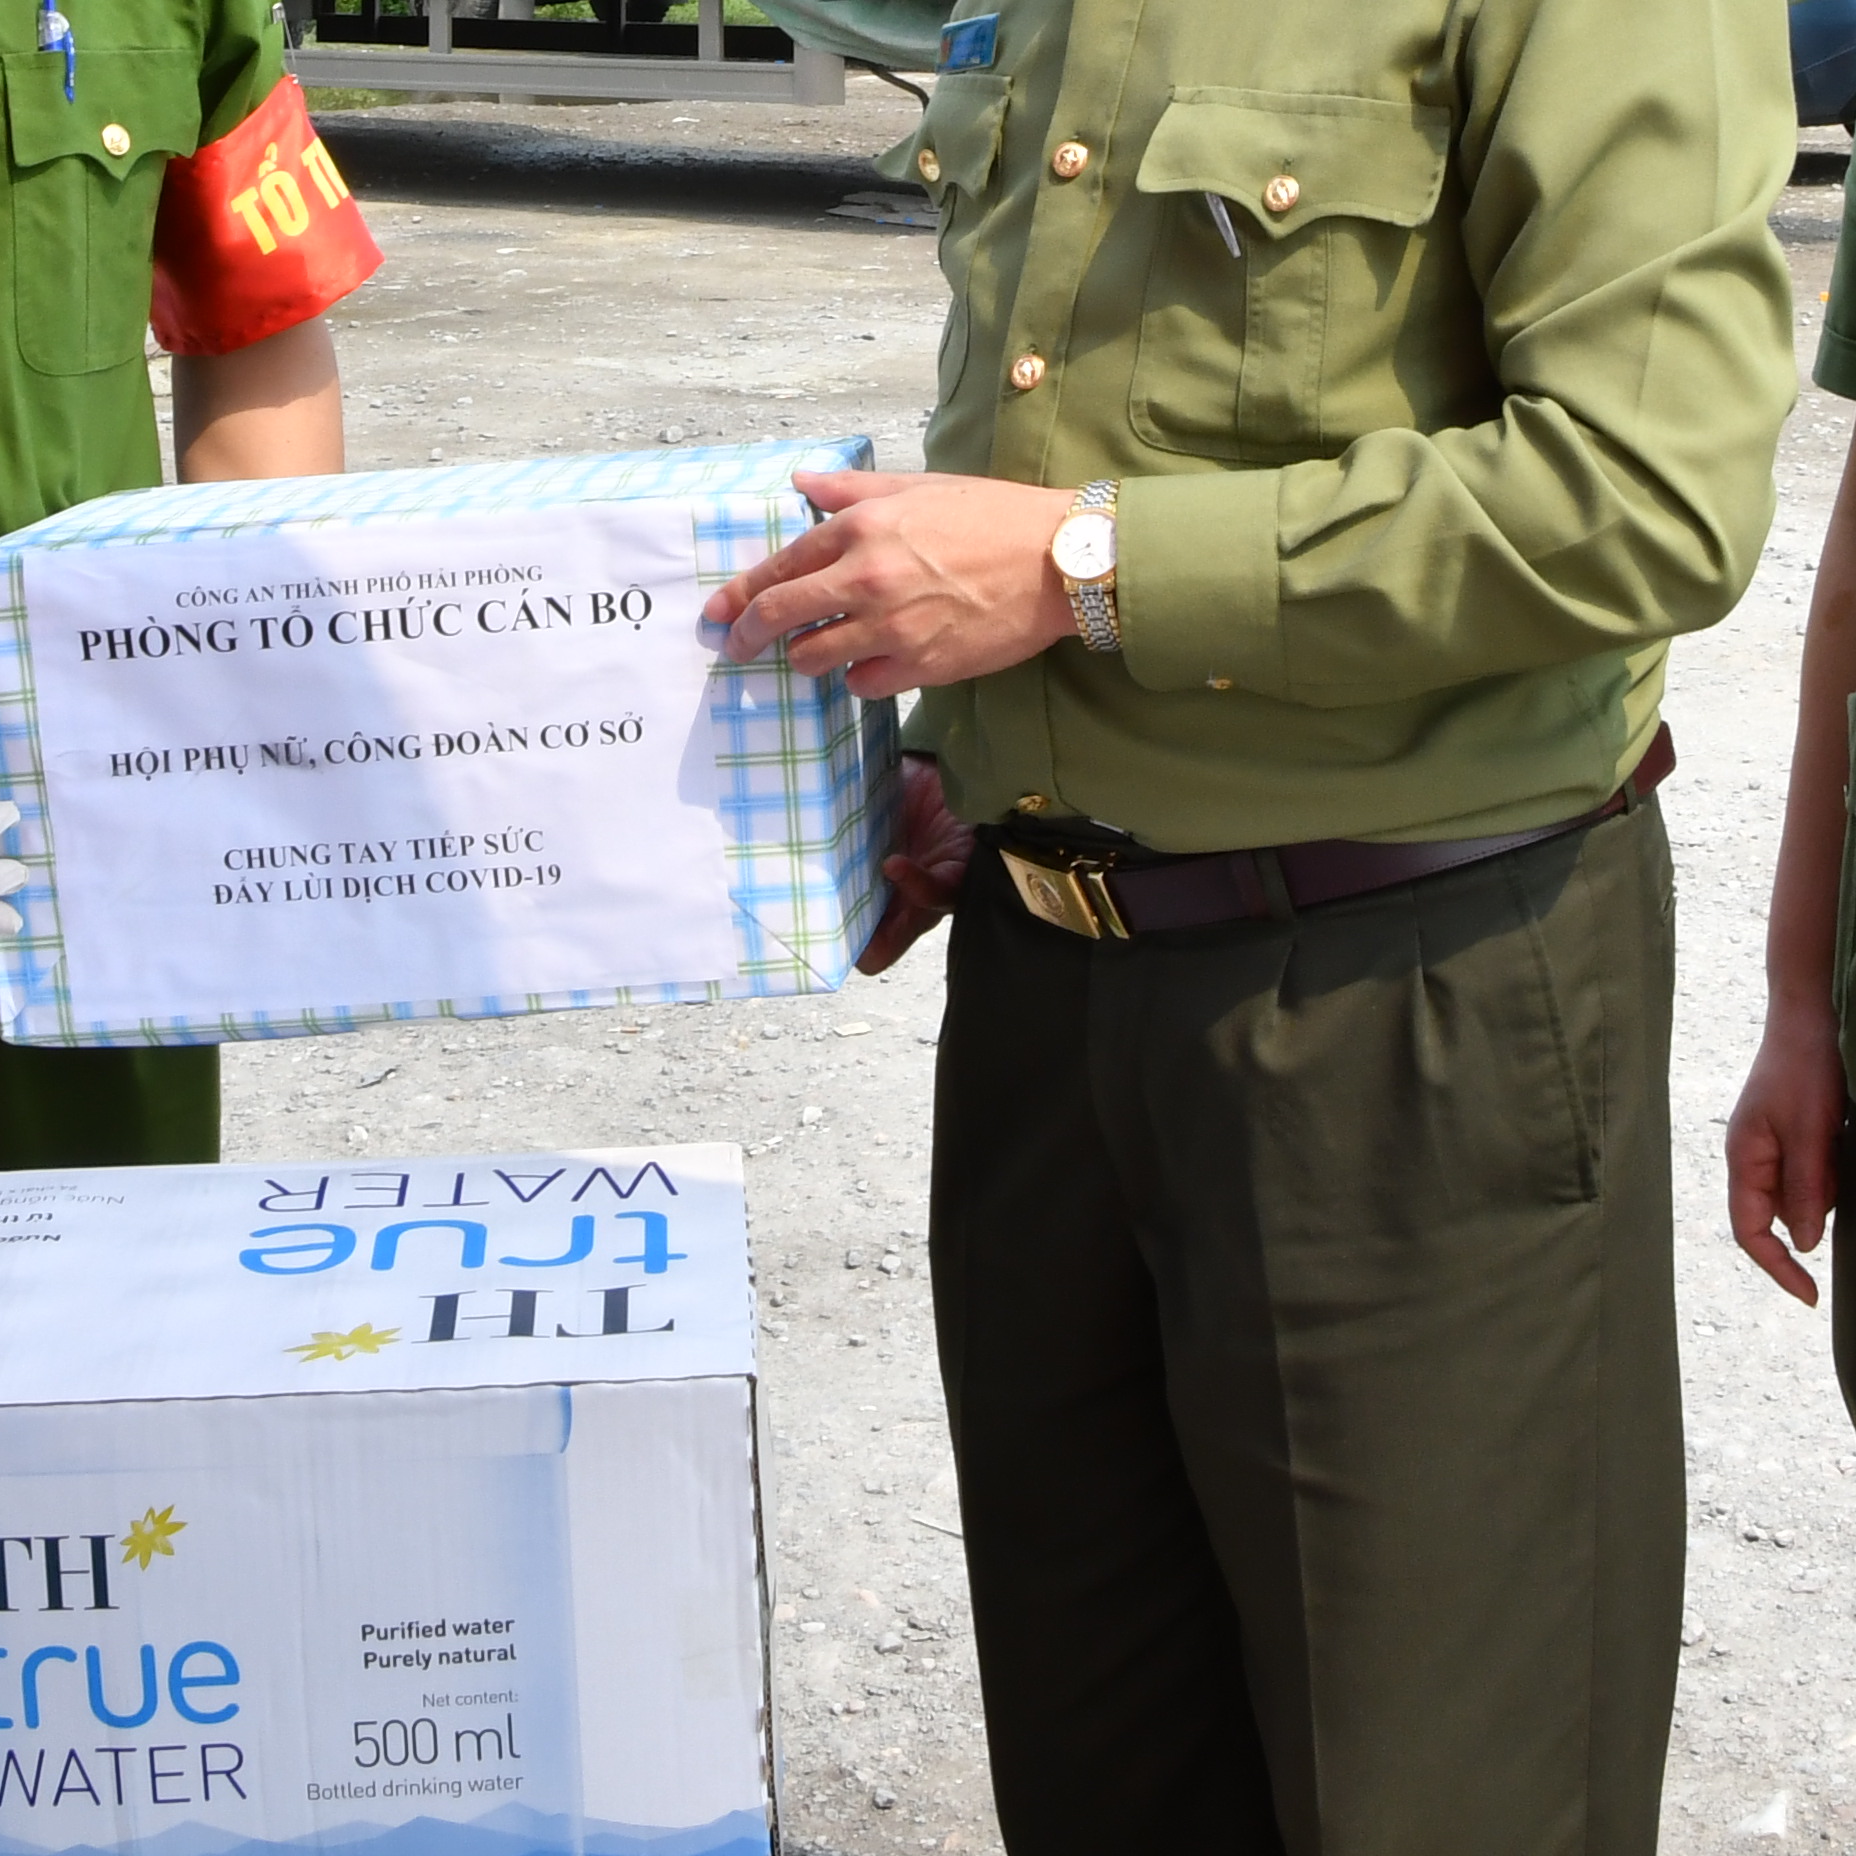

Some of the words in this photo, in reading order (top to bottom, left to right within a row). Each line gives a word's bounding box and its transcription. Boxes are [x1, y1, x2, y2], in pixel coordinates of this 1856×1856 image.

[230, 142, 310, 256] TỔ
[176, 586, 238, 608] CÔNG
[246, 585, 274, 603] AN
[281, 577, 358, 600] THÀNH
[367, 570, 411, 593] PHỐ
[418, 568, 456, 589] HẢI
[465, 564, 542, 586] PHÒNG
[79, 616, 237, 661] PHÒNG
[250, 606, 313, 649] TỔ
[328, 597, 461, 644] CHỨC
[478, 588, 571, 633] CÁN
[591, 584, 652, 630] BỘ
[110, 747, 171, 781] HỘI
[184, 745, 248, 778] PHỤ
[259, 736, 317, 770] NỮ,
[325, 732, 421, 764] CÔNG
[433, 722, 527, 756] ĐOÀN
[540, 721, 589, 749] CƠ
[600, 712, 643, 745] SỞ
[224, 844, 331, 870] CHUNG
[338, 841, 396, 864] TAY
[407, 830, 474, 860] TIẾP
[484, 826, 543, 855] SỨC
[214, 877, 273, 904] ĐẨY
[285, 872, 332, 901] LÙI
[343, 874, 415, 903] DỊCH
[426, 864, 561, 893] COVID-19
[259, 1162, 678, 1212] WATER
[239, 1211, 688, 1275] true
[413, 1285, 674, 1343] TH
[361, 1619, 446, 1641] Purified
[452, 1619, 515, 1636] water
[364, 1649, 432, 1670] Purely
[439, 1643, 516, 1665] natural
[423, 1693, 450, 1708] Net
[455, 1689, 518, 1706] content:
[354, 1718, 438, 1768] 500
[455, 1713, 521, 1762] ml
[307, 1780, 376, 1800] Bottled
[383, 1777, 462, 1798] drinking
[468, 1774, 524, 1792] water
